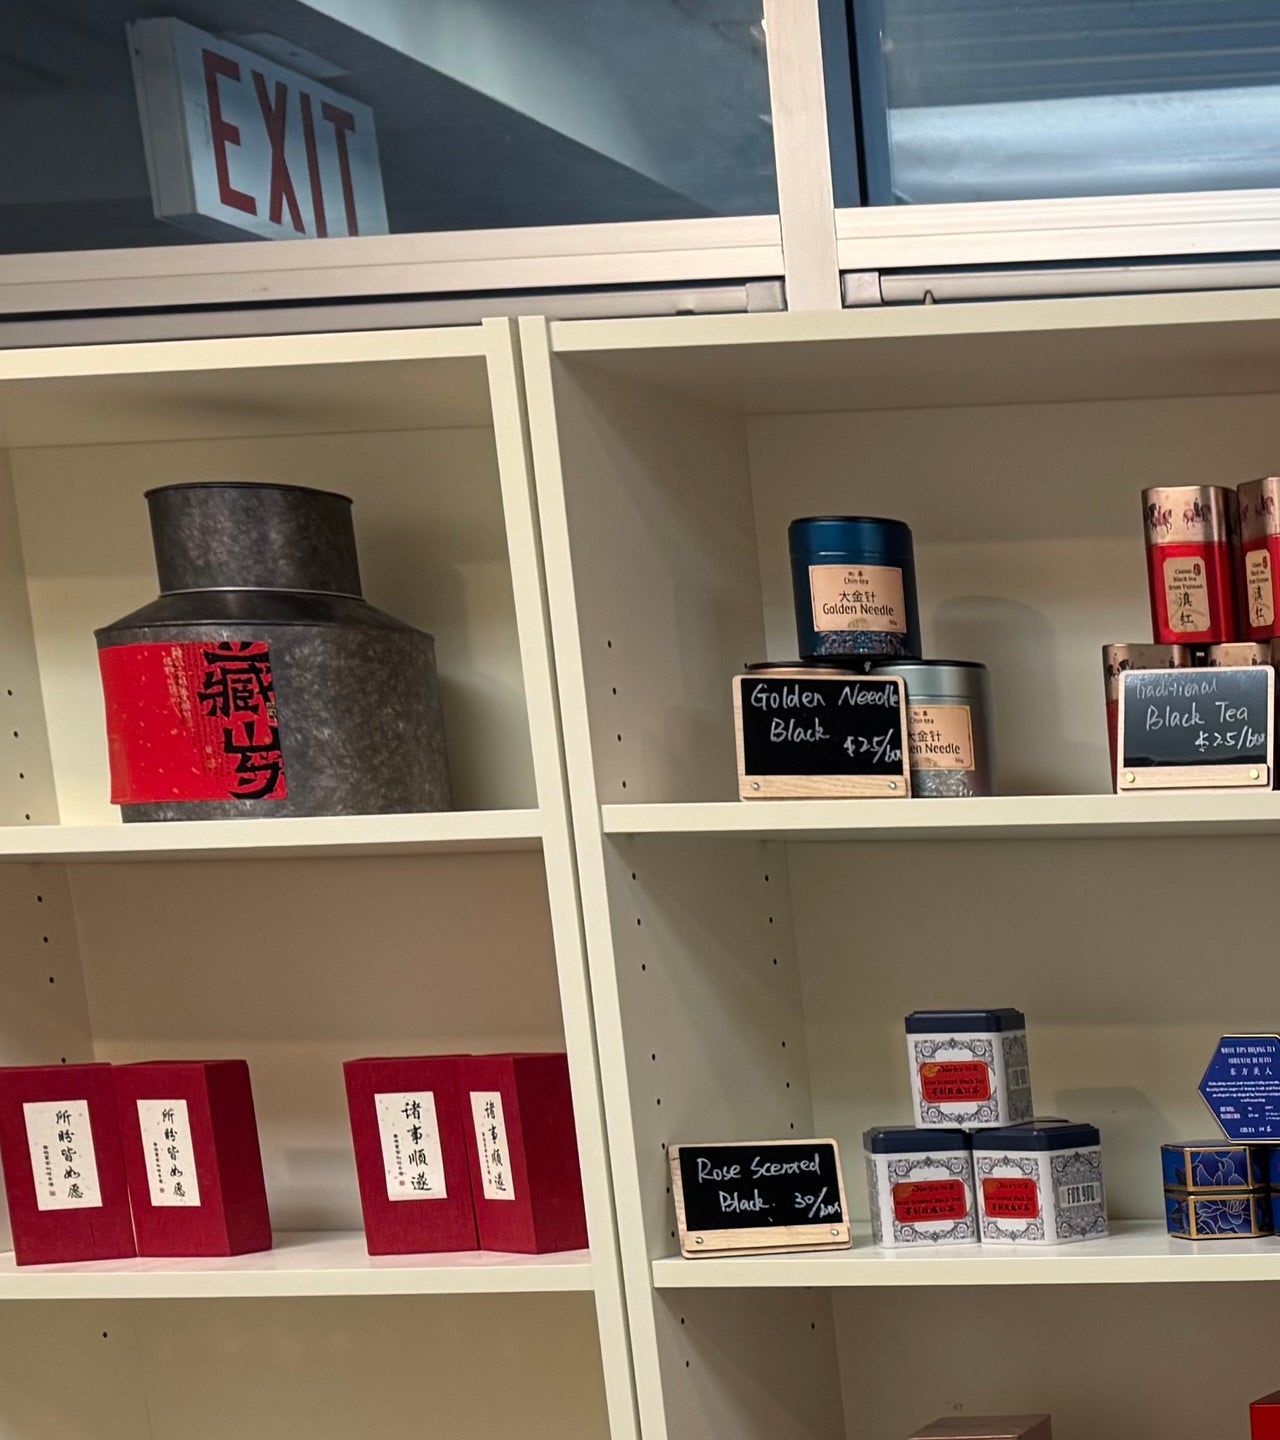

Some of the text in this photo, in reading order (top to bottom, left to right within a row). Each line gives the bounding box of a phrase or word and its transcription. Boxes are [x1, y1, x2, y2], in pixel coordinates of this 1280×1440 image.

[201, 52, 356, 239] EXIT
[839, 591, 876, 603] 大金针
[823, 604, 894, 616] Golden Needle
[751, 683, 899, 711] Golden Needle
[1136, 679, 1217, 699] Traditional
[1146, 701, 1248, 730] Black Tea
[770, 718, 830, 742] Black
[926, 743, 960, 754] Needle
[697, 1158, 741, 1183] Rose
[1067, 1187, 1081, 1205] FOR
